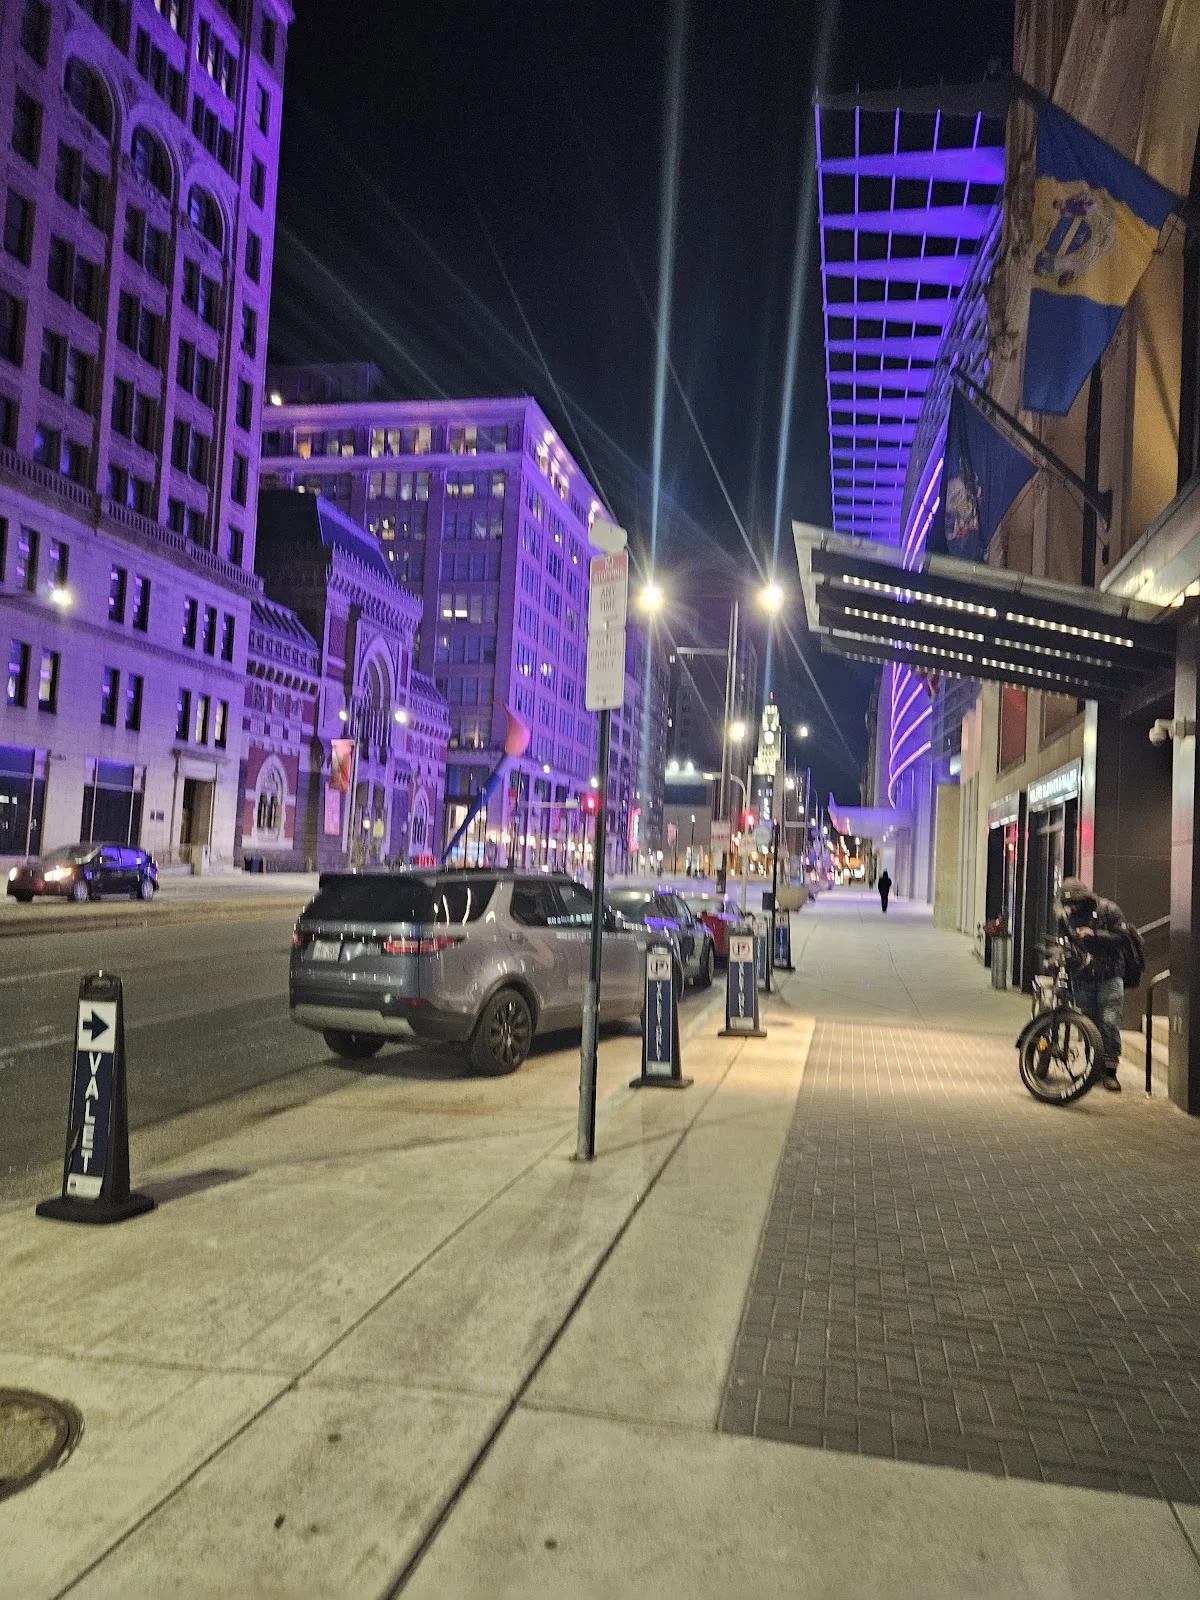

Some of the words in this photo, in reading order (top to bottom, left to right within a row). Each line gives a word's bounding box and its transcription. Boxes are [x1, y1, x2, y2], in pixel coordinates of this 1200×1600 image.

[600, 584, 616, 598] ANY
[600, 598, 615, 612] TIME
[590, 647, 622, 661] PARKING
[81, 1051, 102, 1174] VALET
